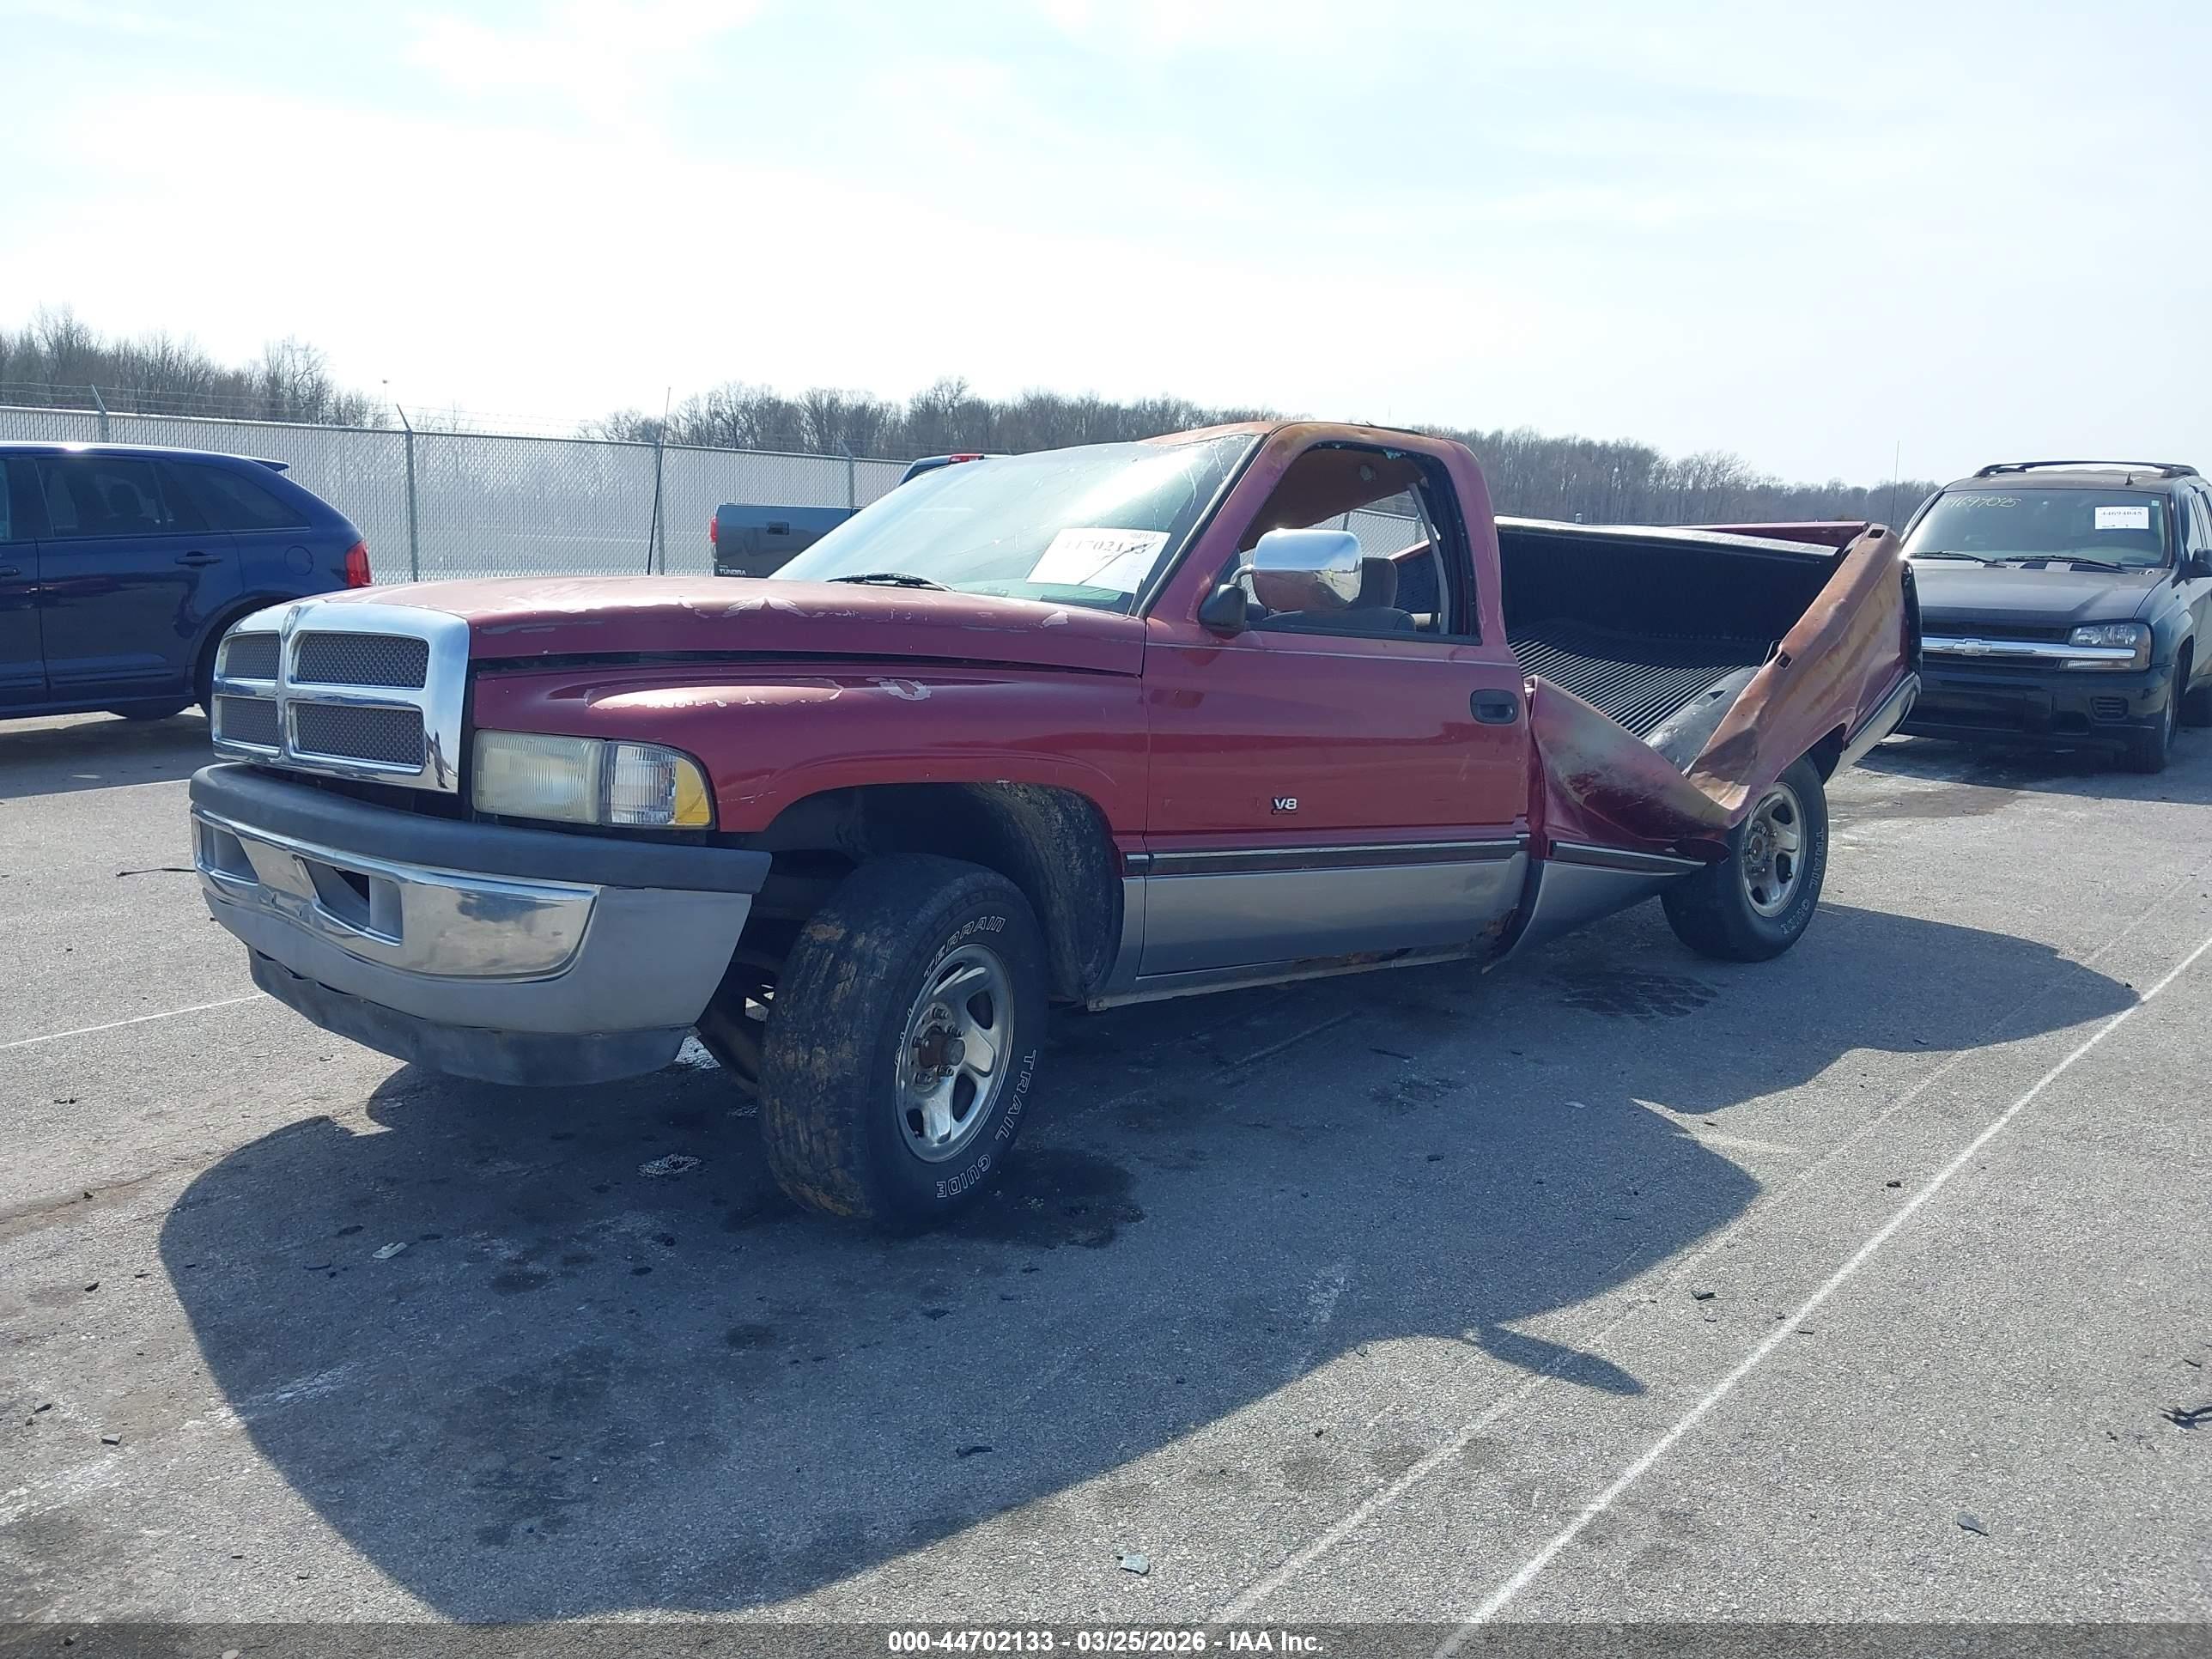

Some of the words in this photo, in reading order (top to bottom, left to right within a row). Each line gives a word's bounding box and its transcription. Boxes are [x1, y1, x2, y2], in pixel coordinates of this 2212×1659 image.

[1273, 798, 1297, 810] V8
[923, 915, 1006, 979] TERRAIN
[994, 1049, 1037, 1140] TRAIL
[936, 1154, 991, 1199] GUIDE
